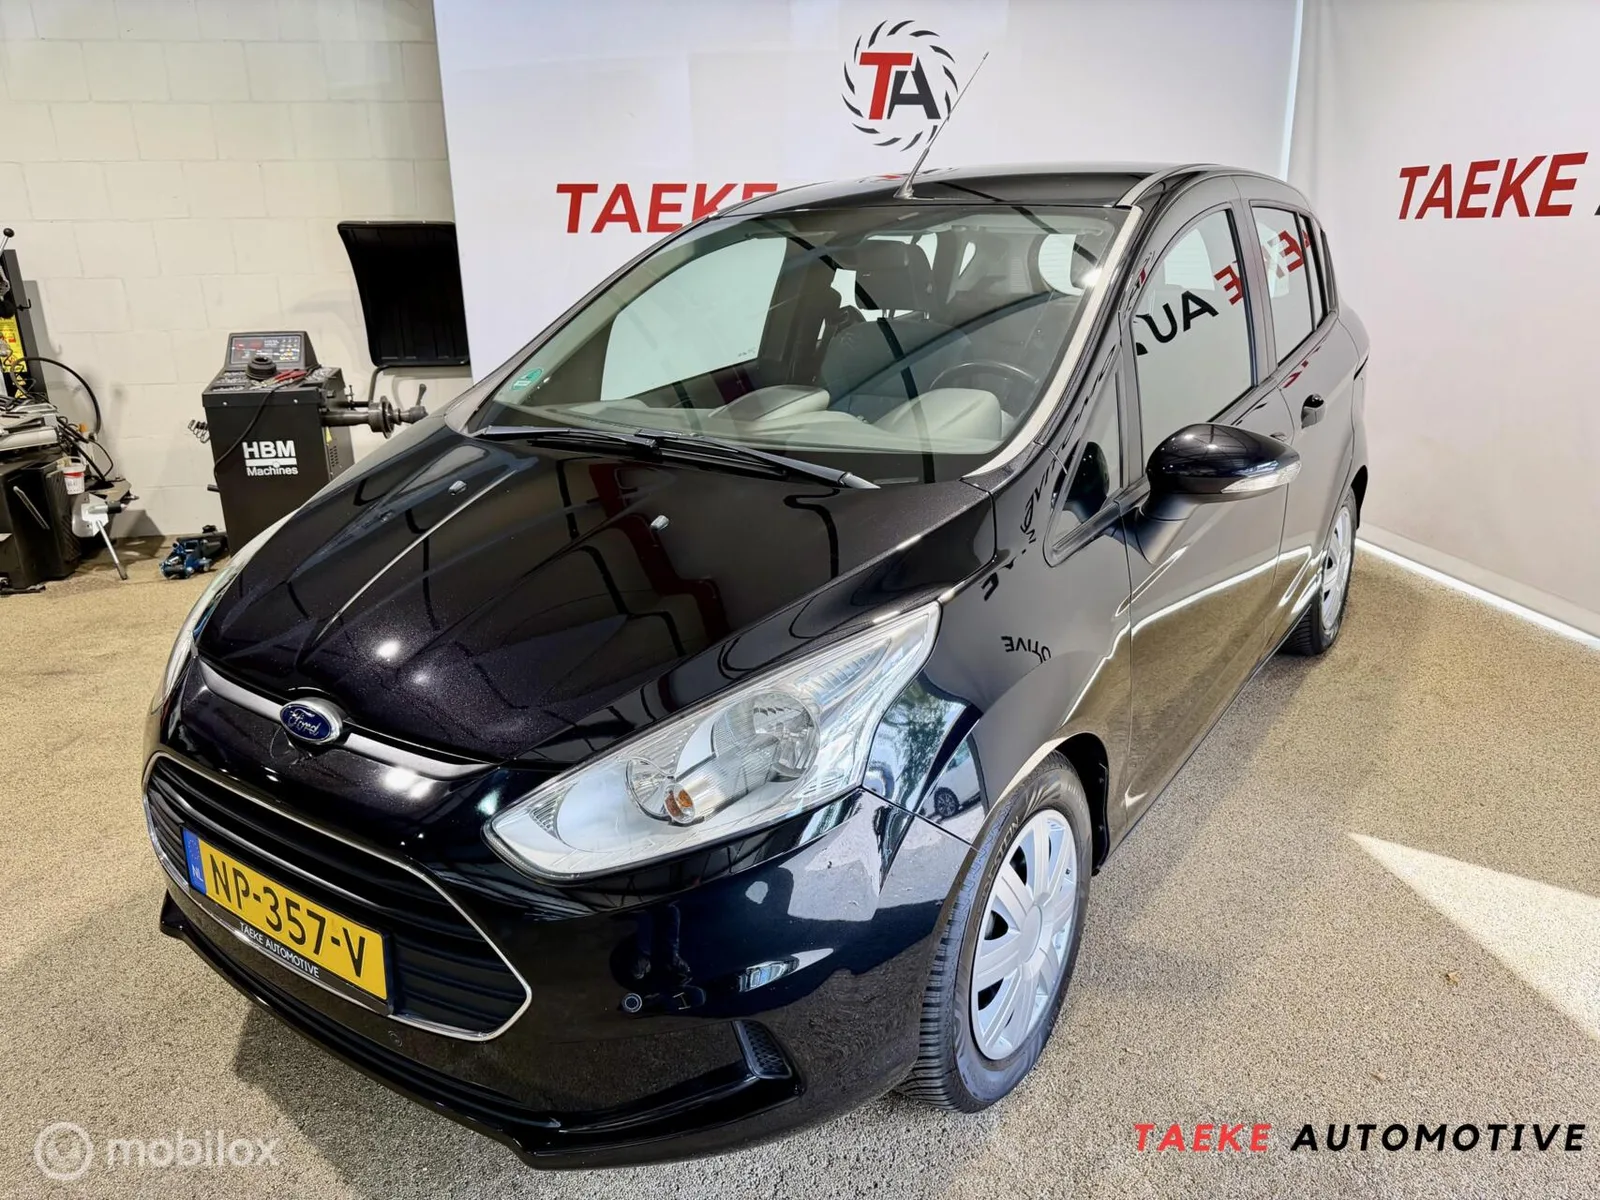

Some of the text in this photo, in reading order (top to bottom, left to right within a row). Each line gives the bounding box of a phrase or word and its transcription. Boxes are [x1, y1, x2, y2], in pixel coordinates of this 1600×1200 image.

[859, 52, 941, 120] TA
[1398, 152, 1588, 220] TAEKE
[242, 440, 296, 459] HBM
[246, 466, 299, 476] Machines
[288, 708, 322, 736] Ford
[192, 863, 204, 882] NL
[210, 854, 366, 978] NP-357-V
[239, 921, 320, 978] TAEKE AUTOMOTIVE
